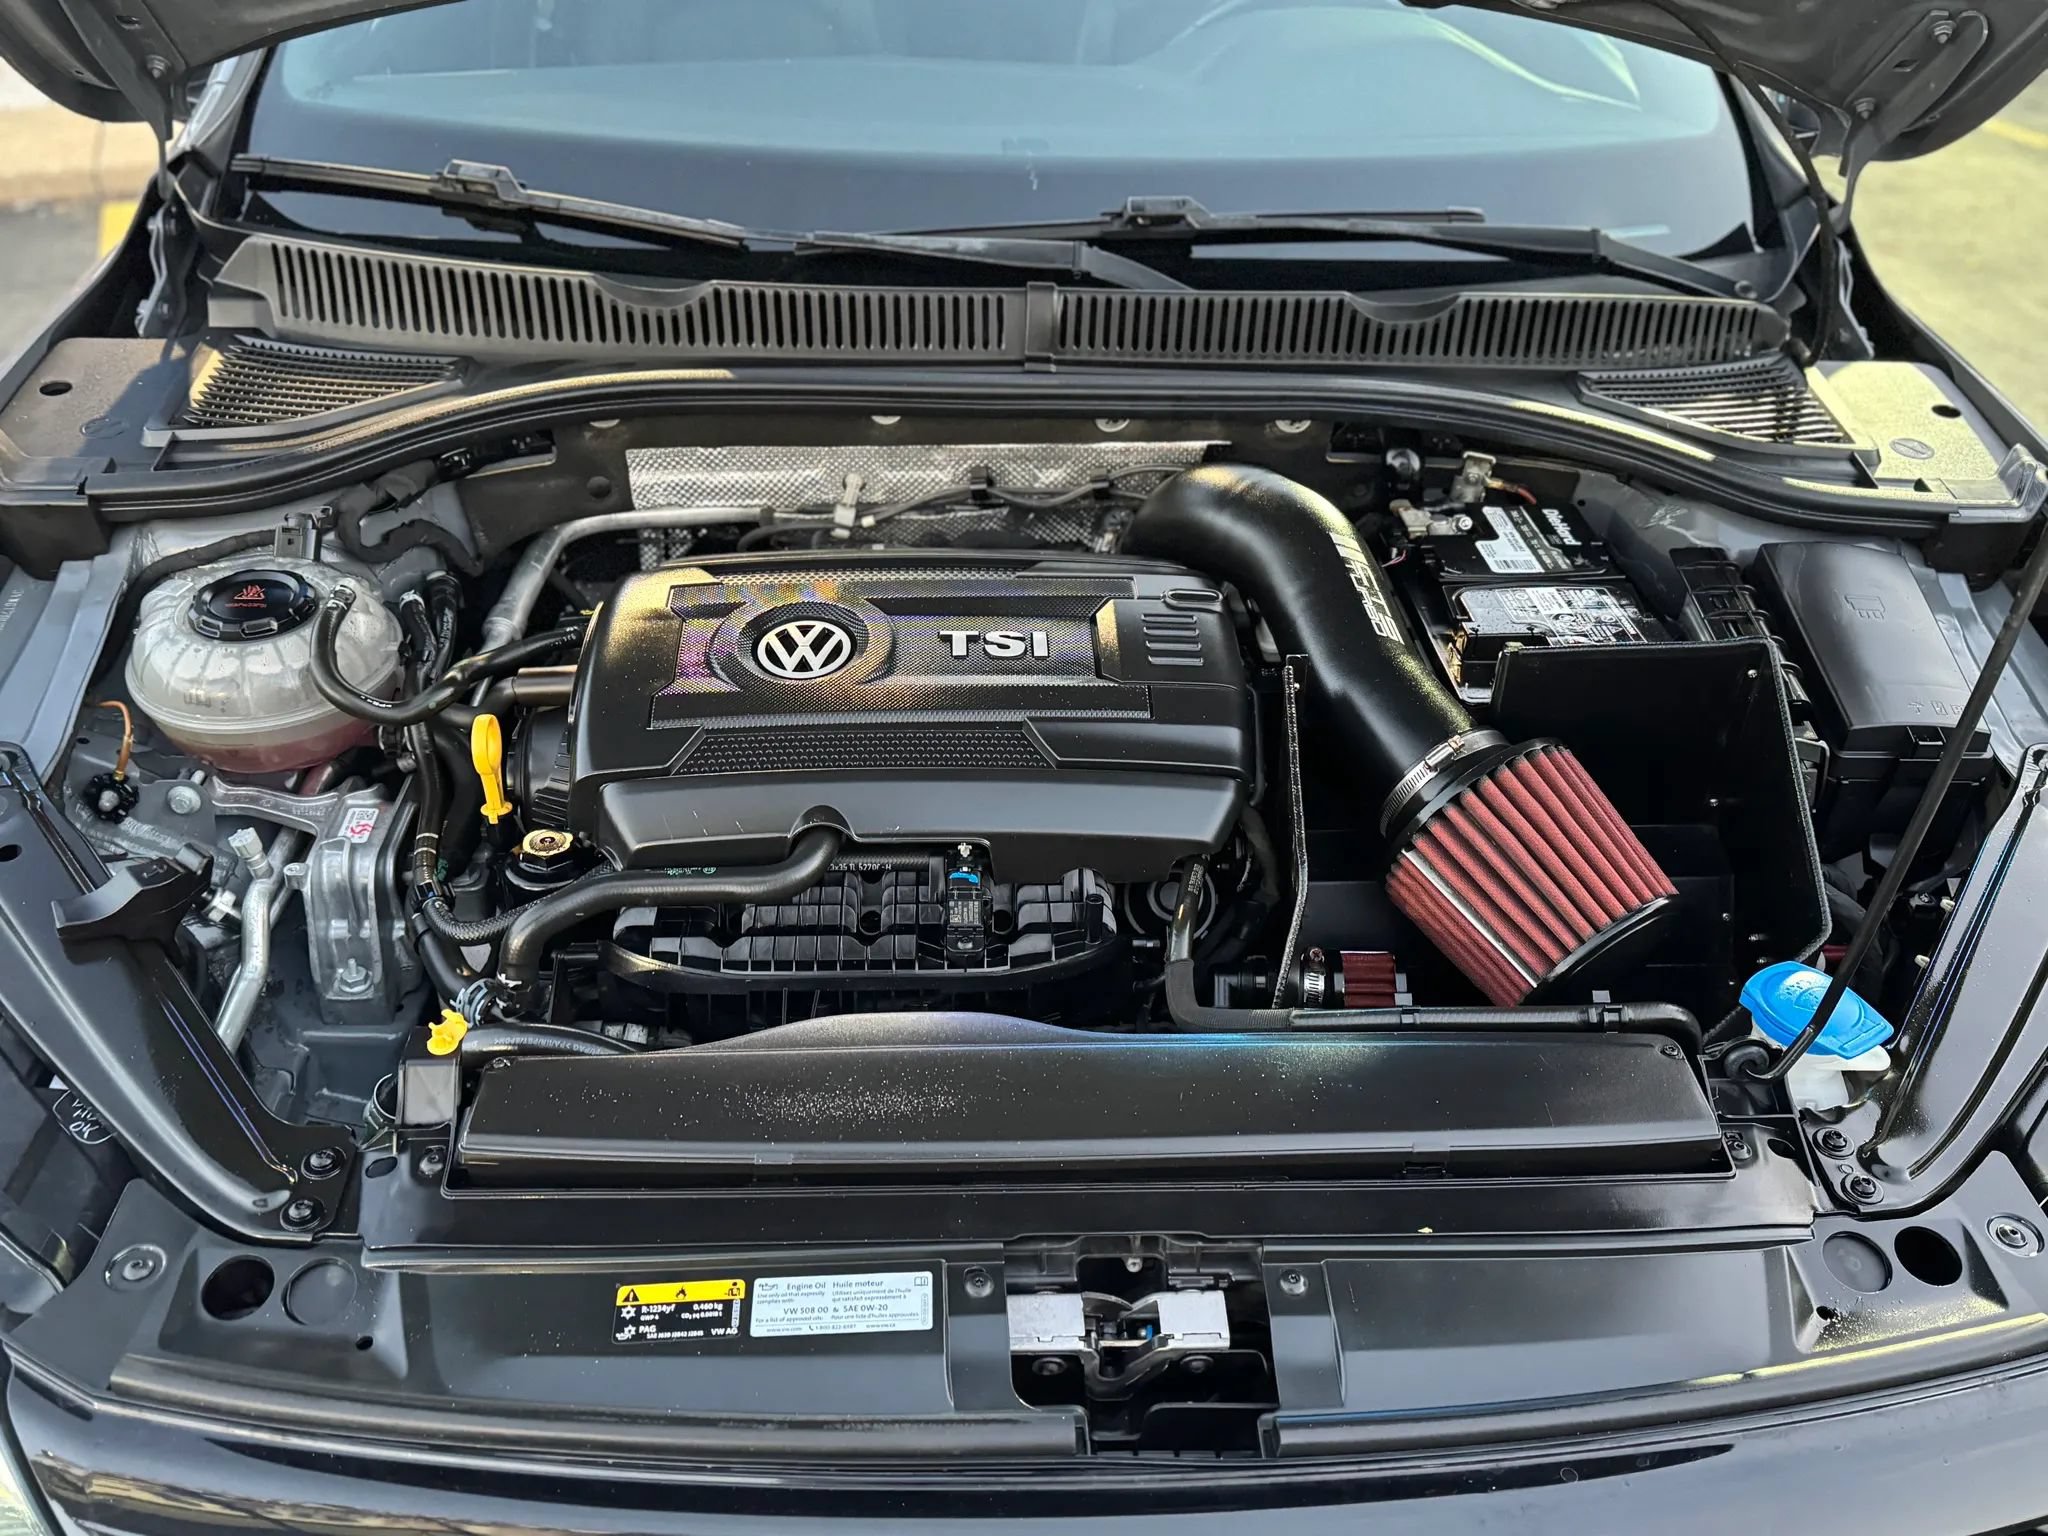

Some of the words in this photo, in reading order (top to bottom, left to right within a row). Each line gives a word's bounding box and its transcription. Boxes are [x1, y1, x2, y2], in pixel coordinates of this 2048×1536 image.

[1541, 509, 1582, 545] DieHard
[1345, 563, 1388, 637] TURBO
[1350, 560, 1405, 645] CTS
[939, 630, 1049, 657] TSI
[757, 619, 851, 681] VW
[787, 1282, 813, 1291] Engine
[641, 1304, 676, 1314] R-1234yf
[714, 1302, 723, 1311] kg
[783, 1307, 798, 1315] VW
[639, 1325, 657, 1333] PAG
[711, 1328, 725, 1336] VW
[726, 1327, 738, 1335] AG
